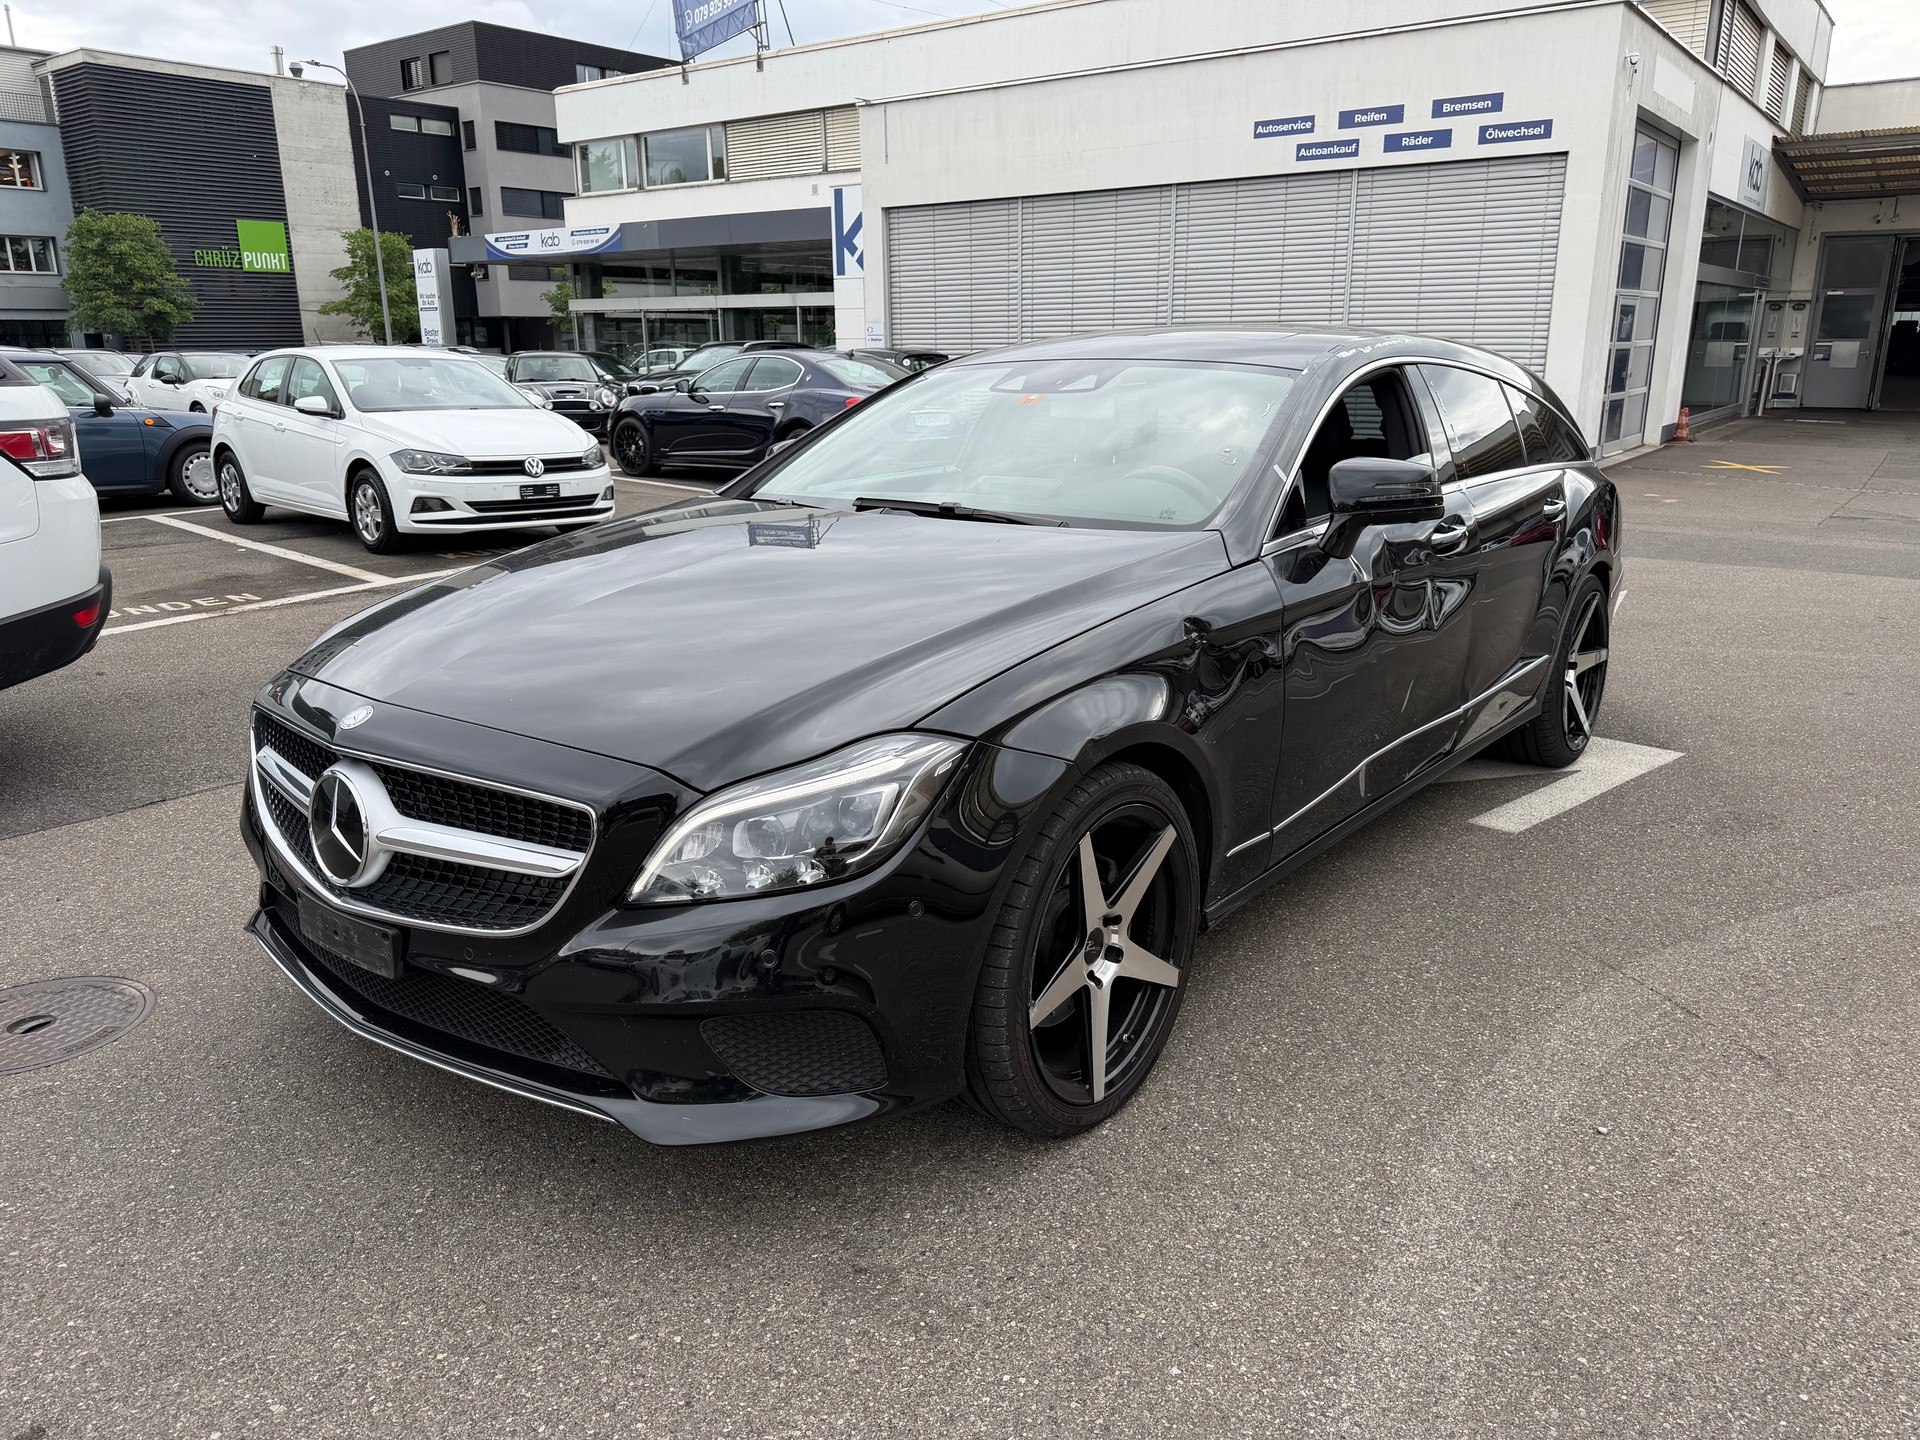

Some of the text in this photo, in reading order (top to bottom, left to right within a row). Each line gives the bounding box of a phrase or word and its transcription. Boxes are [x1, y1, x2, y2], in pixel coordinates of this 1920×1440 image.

[694, 6, 709, 24] 079
[709, 0, 723, 17] 929
[1442, 100, 1492, 113] Bremsen
[1354, 112, 1387, 123] Reifen
[1255, 121, 1312, 135] Autoservice
[1485, 125, 1545, 139] Ölwechsel
[1401, 135, 1433, 147] Räder
[1298, 143, 1357, 157] Autoankauf
[1746, 144, 1763, 193] kab
[540, 231, 560, 248] kab
[416, 257, 433, 274] kab
[424, 328, 439, 337] Bester
